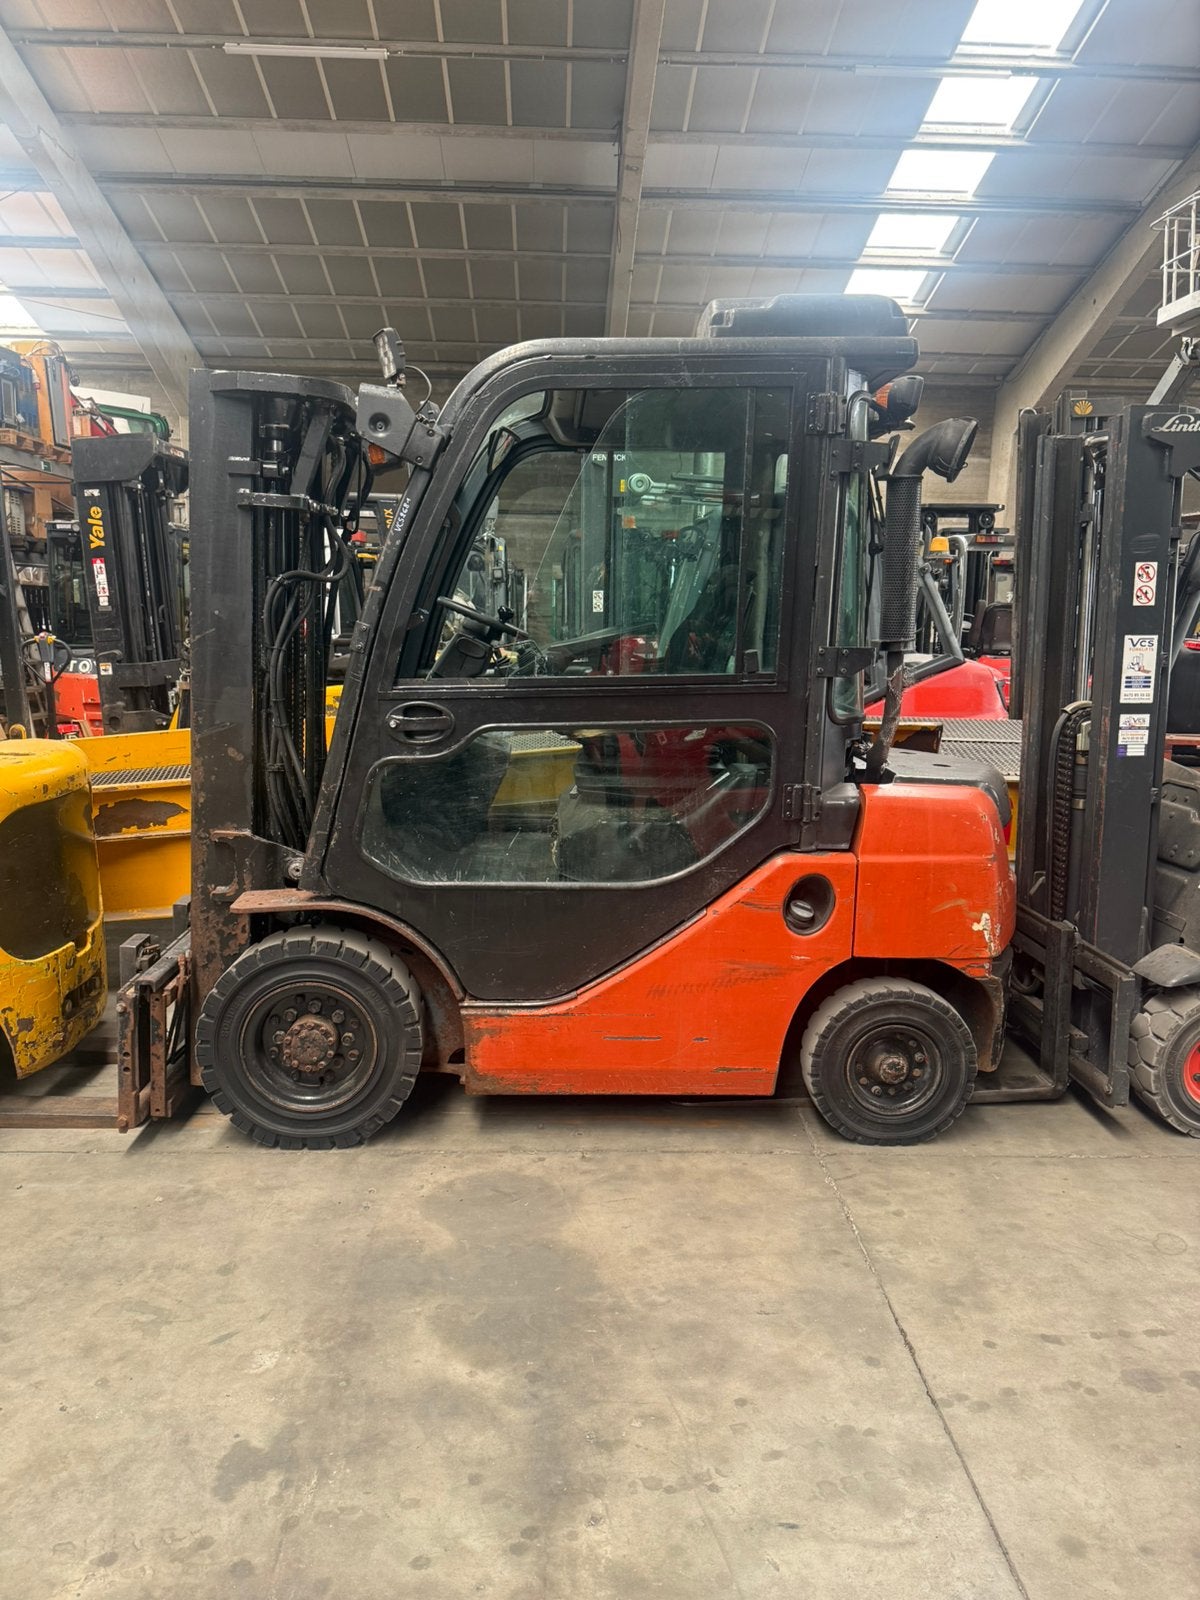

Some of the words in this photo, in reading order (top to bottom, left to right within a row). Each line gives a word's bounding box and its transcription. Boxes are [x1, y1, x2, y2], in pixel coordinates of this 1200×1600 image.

[592, 453, 627, 462] FENICK
[89, 506, 105, 549] Yale
[69, 660, 97, 673] TO
